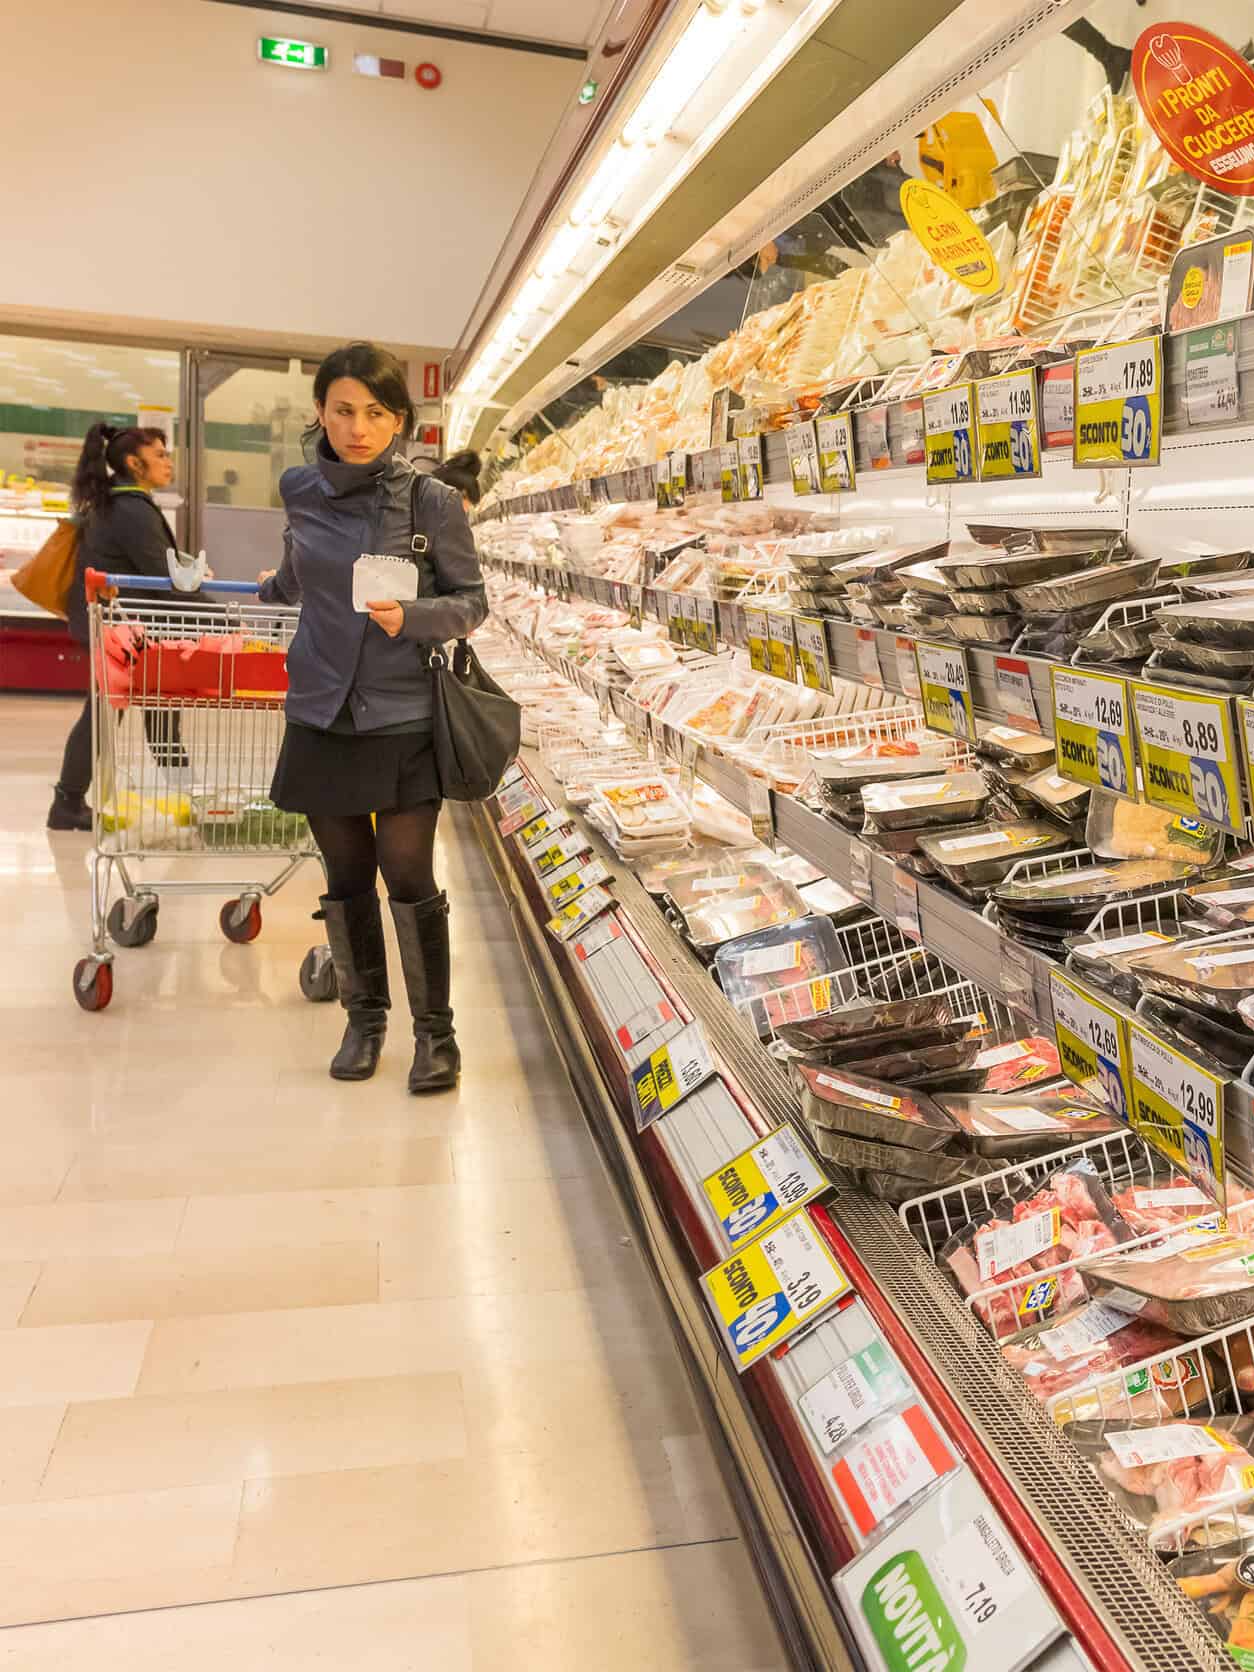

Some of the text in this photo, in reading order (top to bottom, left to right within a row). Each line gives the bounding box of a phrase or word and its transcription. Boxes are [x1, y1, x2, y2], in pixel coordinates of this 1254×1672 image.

[1158, 66, 1231, 118] I PRONTI
[1196, 105, 1221, 126] DA
[927, 220, 961, 242] CARNI
[931, 236, 985, 263] MARINATE
[1123, 358, 1153, 393] 17,89
[1009, 390, 1032, 417] 11,99
[1080, 421, 1118, 445] SCONTO
[1095, 696, 1122, 728] 12,69
[1060, 737, 1095, 766] SCONTO
[1183, 719, 1218, 755] 8,89
[1148, 764, 1190, 796] SCONTO
[1089, 1019, 1118, 1058] 12,69
[1062, 1041, 1095, 1076] SCONTO
[1180, 1080, 1215, 1126] 12,99
[718, 1167, 749, 1207] SCONTO
[777, 1170, 810, 1206] 13,99
[723, 1257, 759, 1308] SCONTO
[787, 1271, 822, 1310] 3,19
[825, 1415, 848, 1443] 4,28
[963, 1581, 998, 1624] 7,19
